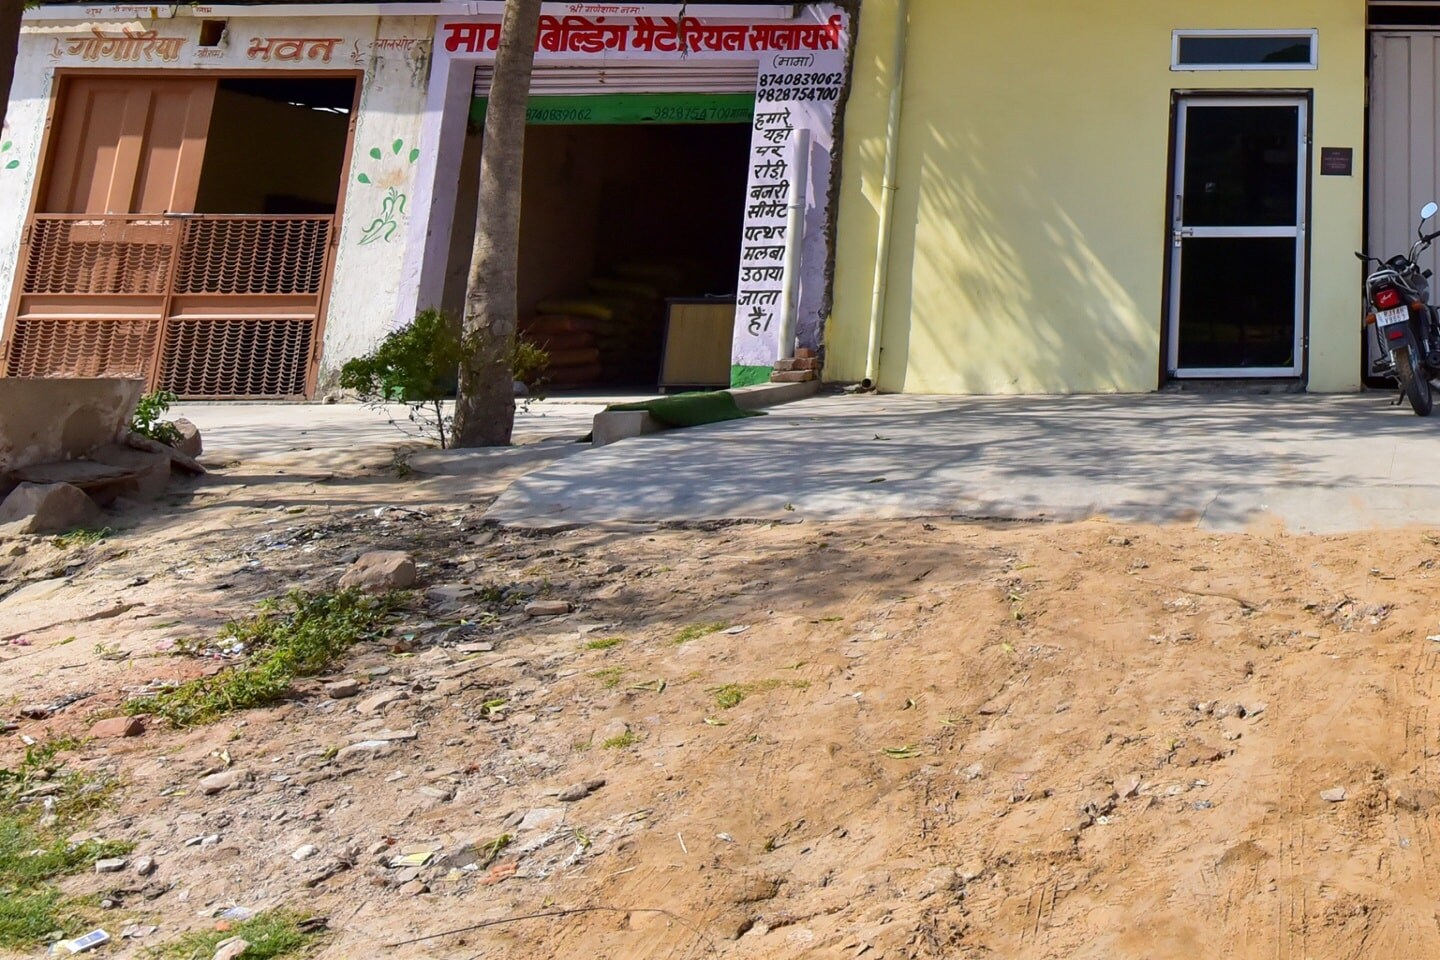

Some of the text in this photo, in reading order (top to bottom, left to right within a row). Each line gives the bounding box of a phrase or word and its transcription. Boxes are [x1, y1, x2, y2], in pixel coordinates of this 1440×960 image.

[534, 15, 630, 54] बिल्डिंग
[246, 36, 344, 63] भवन
[759, 72, 842, 87] 8740839062
[757, 87, 839, 103] 9828754700
[754, 107, 791, 131] हमारे
[750, 180, 790, 201] बजरी
[747, 199, 789, 219] सीमेंट
[745, 225, 787, 242] पत्थर
[743, 245, 786, 261] मलबा
[741, 266, 785, 282] उठाया
[738, 290, 783, 306] जाता
